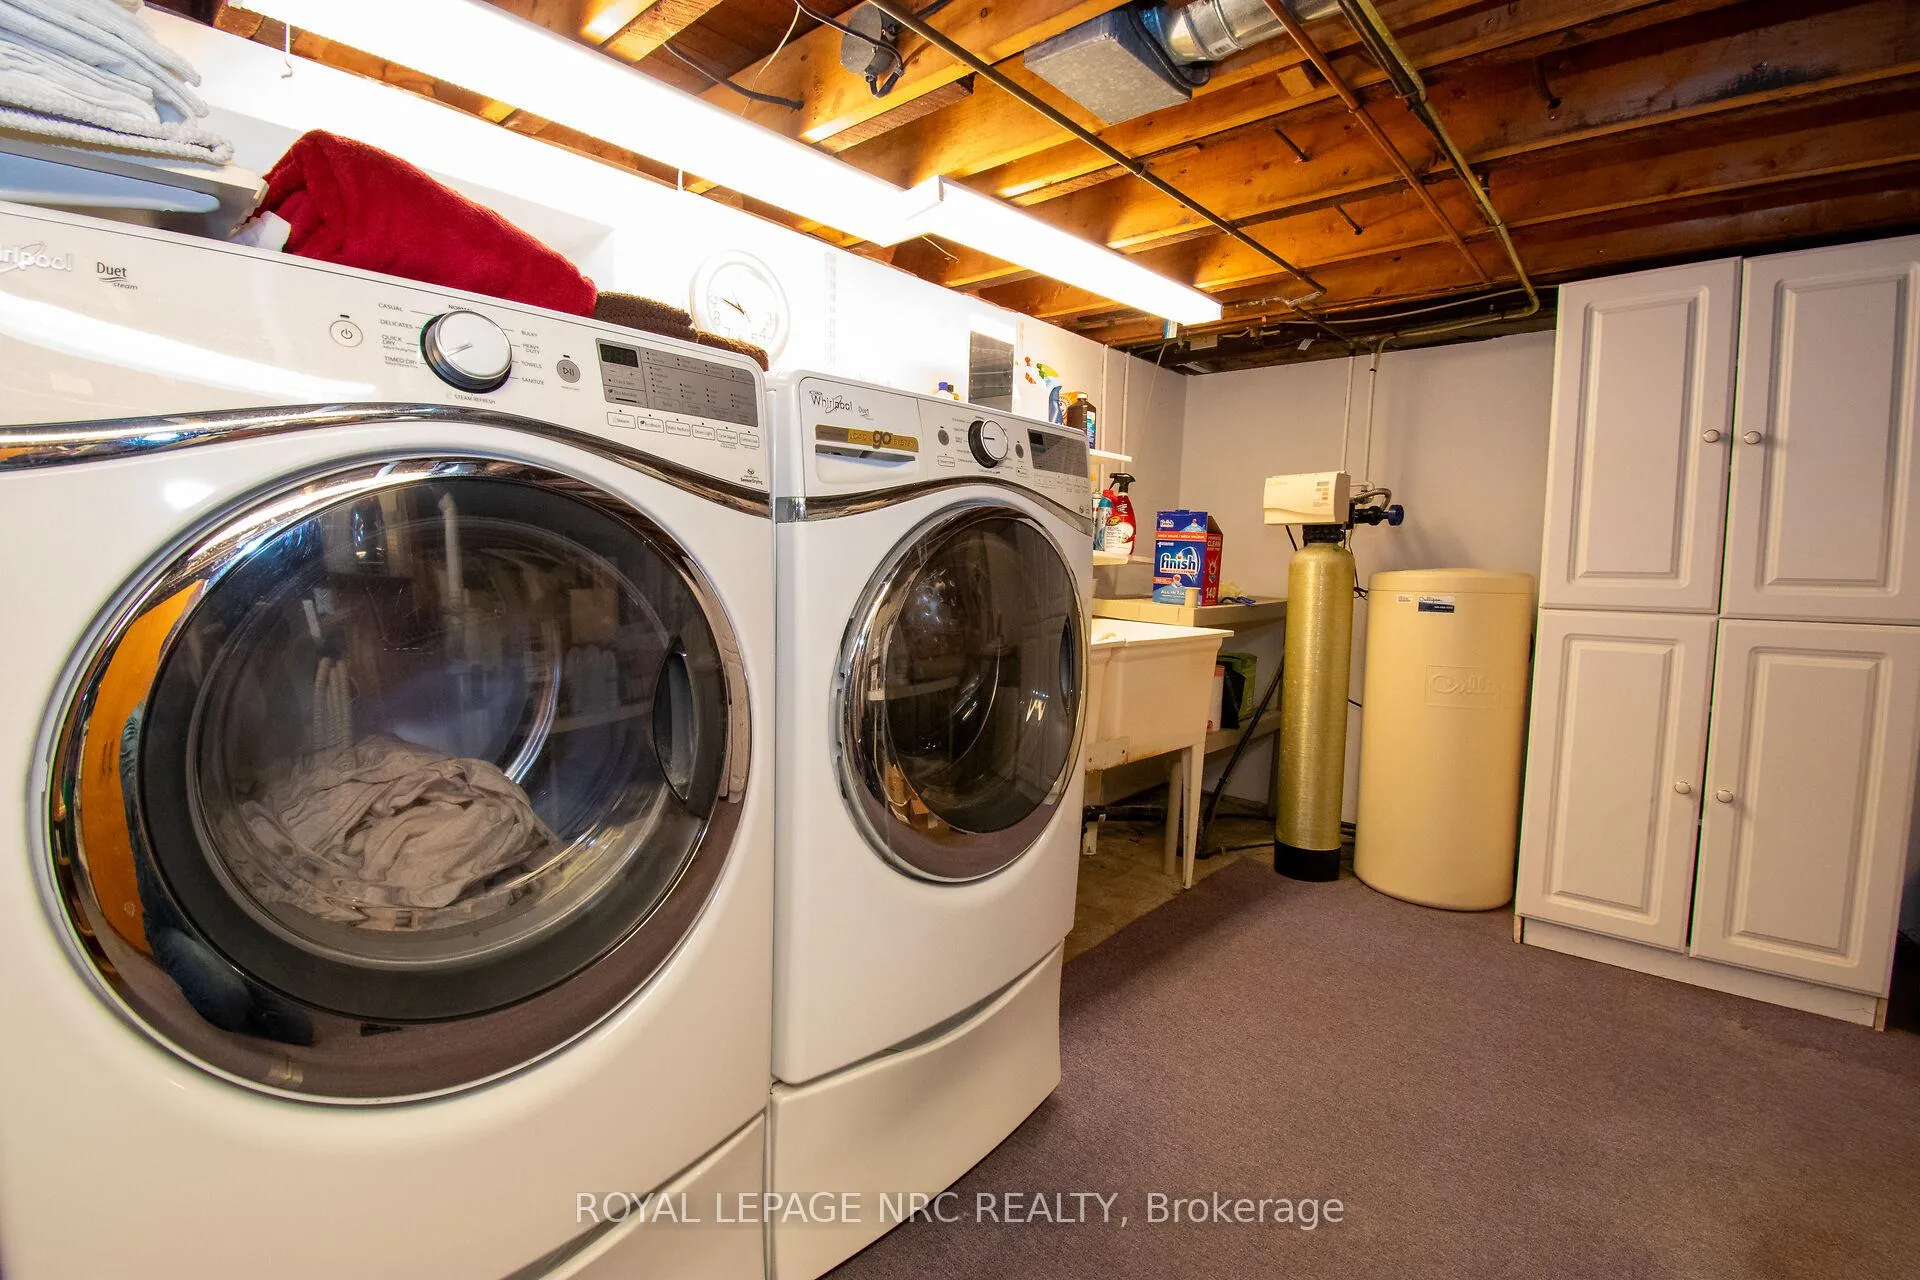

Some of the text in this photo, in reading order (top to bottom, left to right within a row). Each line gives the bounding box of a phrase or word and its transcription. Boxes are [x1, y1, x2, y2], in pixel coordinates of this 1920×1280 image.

[96, 261, 127, 278] Duet
[113, 281, 138, 290] steam
[378, 302, 404, 312] CASUAL
[448, 304, 473, 312] NORM
[380, 319, 414, 330] DELICATES
[454, 393, 473, 402] STEAM
[810, 394, 853, 413] Whirlpool
[871, 430, 892, 449] go
[1160, 552, 1197, 571] finish
